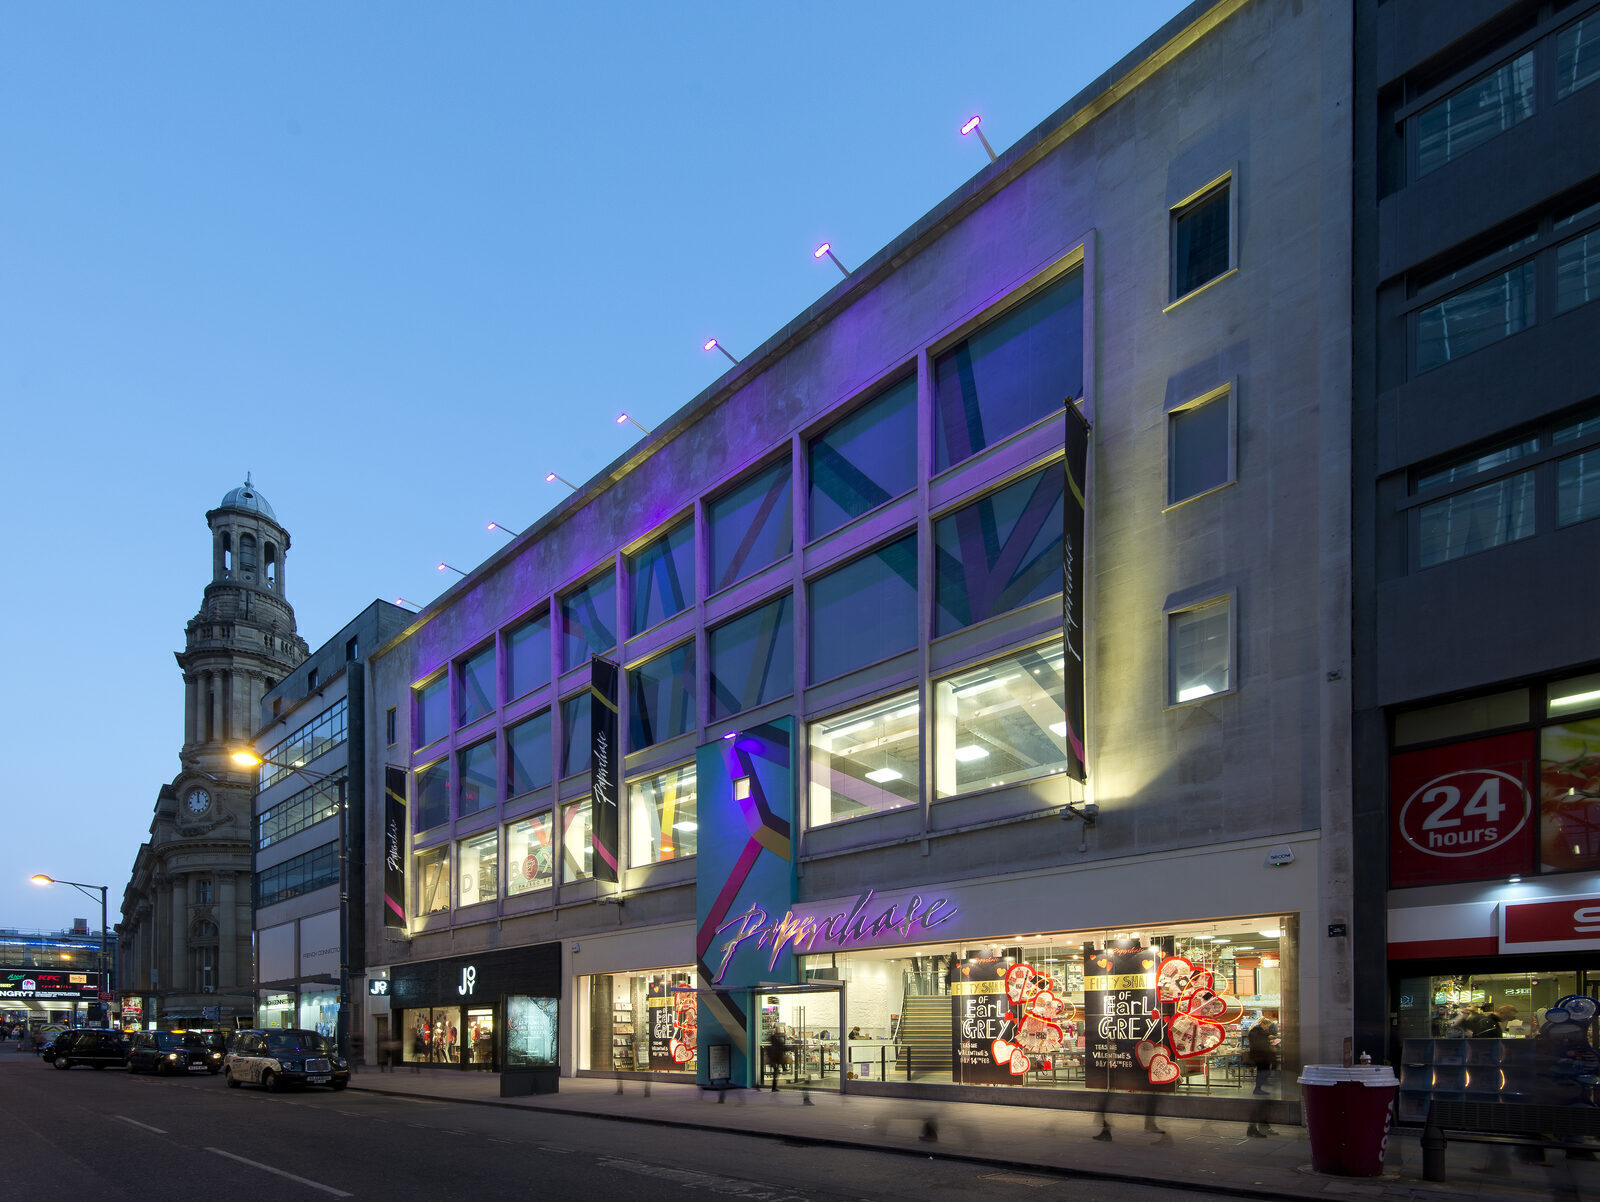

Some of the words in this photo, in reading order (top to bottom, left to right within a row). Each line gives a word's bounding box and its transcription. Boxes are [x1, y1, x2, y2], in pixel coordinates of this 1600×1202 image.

[593, 730, 616, 807] Paperchase
[1422, 778, 1506, 830] 24
[1429, 827, 1498, 848] hours
[711, 889, 958, 984] Paperchase
[370, 980, 387, 995] JOY
[458, 965, 476, 996] JOY
[978, 996, 988, 1004] OF
[1119, 991, 1131, 1000] OF
[962, 1019, 1010, 1040] GREY
[1098, 1016, 1160, 1041] GREY
